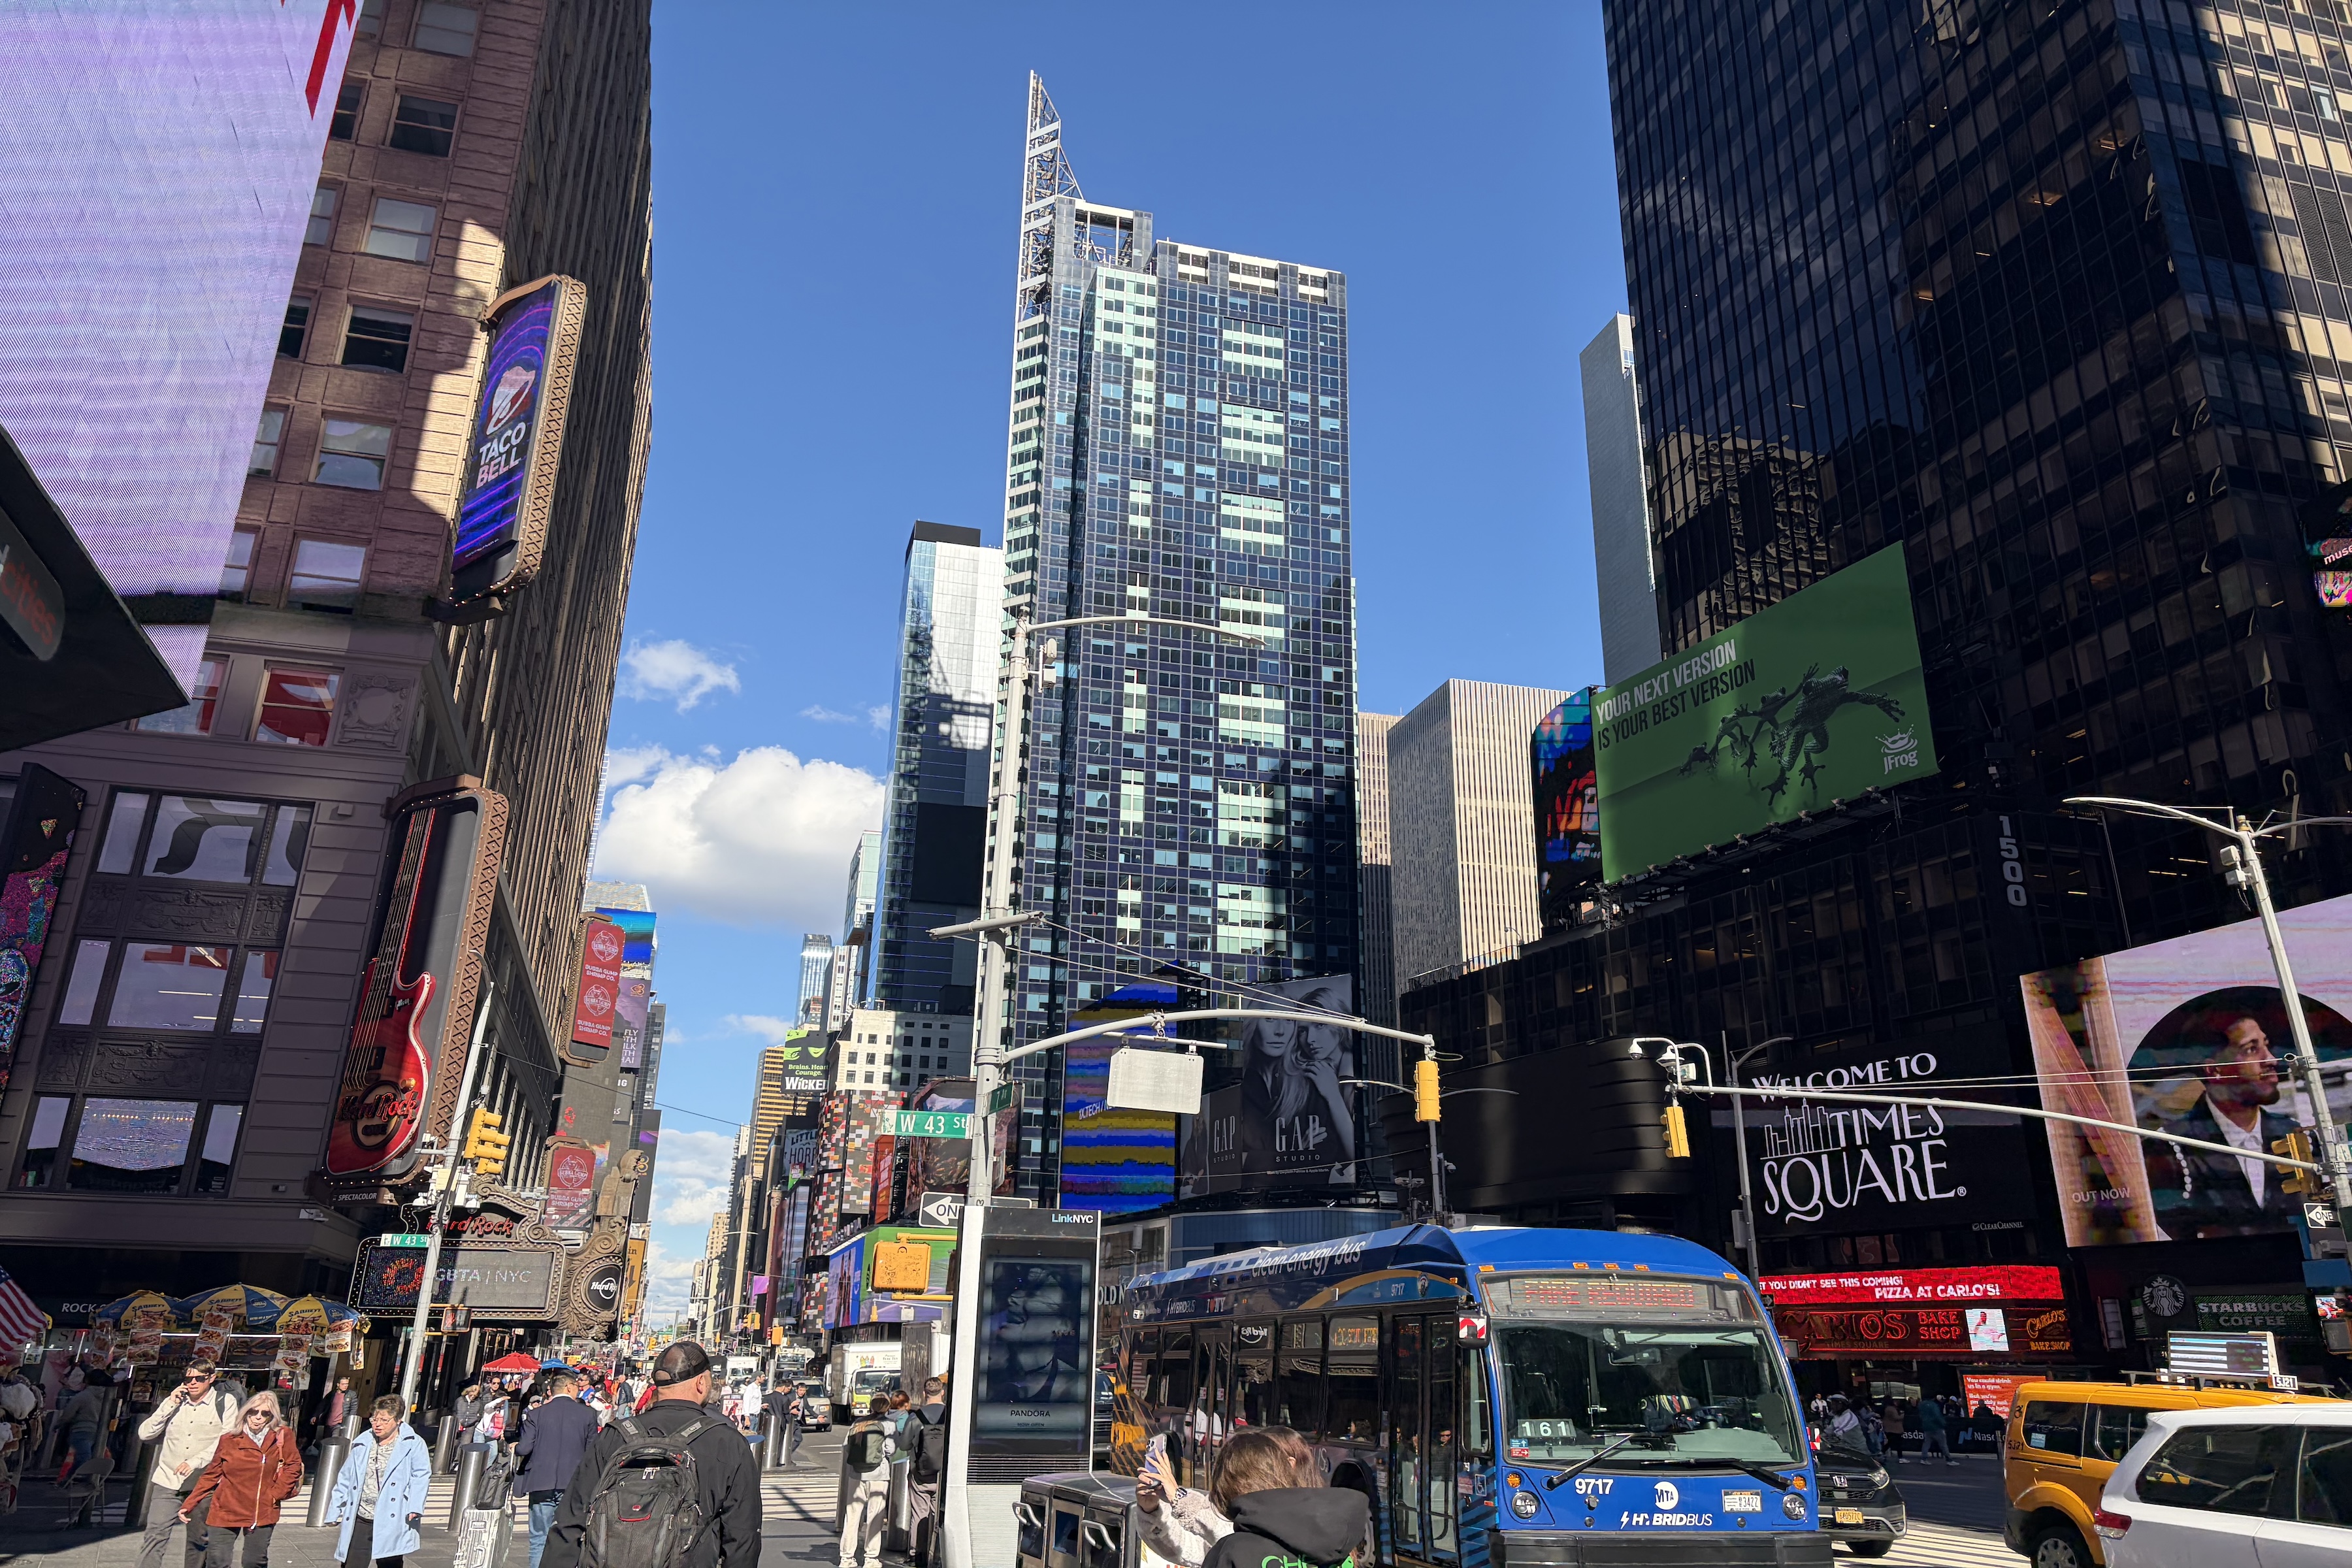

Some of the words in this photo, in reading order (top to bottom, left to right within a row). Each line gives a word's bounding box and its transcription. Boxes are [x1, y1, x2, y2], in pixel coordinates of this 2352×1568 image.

[479, 422, 526, 466] TACO
[476, 449, 521, 489] BELL
[1595, 693, 1631, 725] YOUR
[1633, 671, 1670, 708] NEXT
[1673, 639, 1737, 688] VERSION
[1598, 727, 1609, 751] IS
[1612, 710, 1648, 744] YOUR
[1653, 691, 1687, 727] BEST
[1691, 659, 1756, 708] VERSION
[1884, 750, 1918, 775] JFrog
[1999, 815, 2026, 907] 1500
[585, 964, 602, 973] BUBBA
[578, 1020, 594, 1028] BUBBA
[1752, 1060, 1893, 1103] WELCOME
[1895, 1053, 1936, 1078] TO
[996, 1092, 1000, 1105] 7
[376, 1092, 417, 1122] Rock
[900, 1114, 915, 1132] W
[924, 1115, 945, 1134] 43
[953, 1117, 966, 1128] St
[1830, 1103, 1945, 1148] TIMES
[1214, 1115, 1235, 1153] GAP
[1276, 1115, 1320, 1152] GAP
[1214, 1154, 1235, 1163] STUDIO
[1765, 1139, 1955, 1224] SQUARE
[338, 1192, 378, 1201] SPECTACOLOR
[2072, 1191, 2097, 1203] OUT
[2101, 1187, 2131, 1201] NOW
[472, 1216, 514, 1235] Rock
[1052, 1214, 1093, 1224] LinkNYC
[393, 1236, 403, 1245] W
[405, 1235, 416, 1245] 43
[1334, 1239, 1365, 1266] bus
[496, 1269, 531, 1282] NYC
[1769, 1281, 1786, 1290] YOU
[1789, 1279, 1816, 1289] DIDN'T
[1820, 1278, 1837, 1288] SEE
[1838, 1277, 1859, 1287] THIS
[1862, 1276, 1903, 1286] COMING!
[591, 1282, 608, 1290] Hard
[1391, 1282, 1405, 1296] 9717
[1875, 1286, 1912, 1299] PIZZA
[1916, 1286, 1932, 1298] AT
[1936, 1283, 2000, 1297] CARLO'S!
[1098, 1286, 1117, 1305] OLD
[61, 1303, 96, 1313] ROCK
[1215, 1297, 1226, 1313] NY
[2197, 1303, 2306, 1313] STARBUCKS
[1918, 1311, 1959, 1324] BAKE
[2027, 1309, 2066, 1338] CARLO'S
[2219, 1316, 2286, 1326] COFFEE
[1920, 1327, 1961, 1339] SHOP
[2030, 1342, 2050, 1350] BAKE
[2051, 1341, 2070, 1350] SHOP
[2276, 1377, 2294, 1387] 5J21
[1522, 1420, 1569, 1437] 161
[1902, 1429, 1924, 1439] asda
[1575, 1478, 1614, 1494] 9717
[1656, 1488, 1674, 1503] MTA
[1743, 1497, 1758, 1507] 3422
